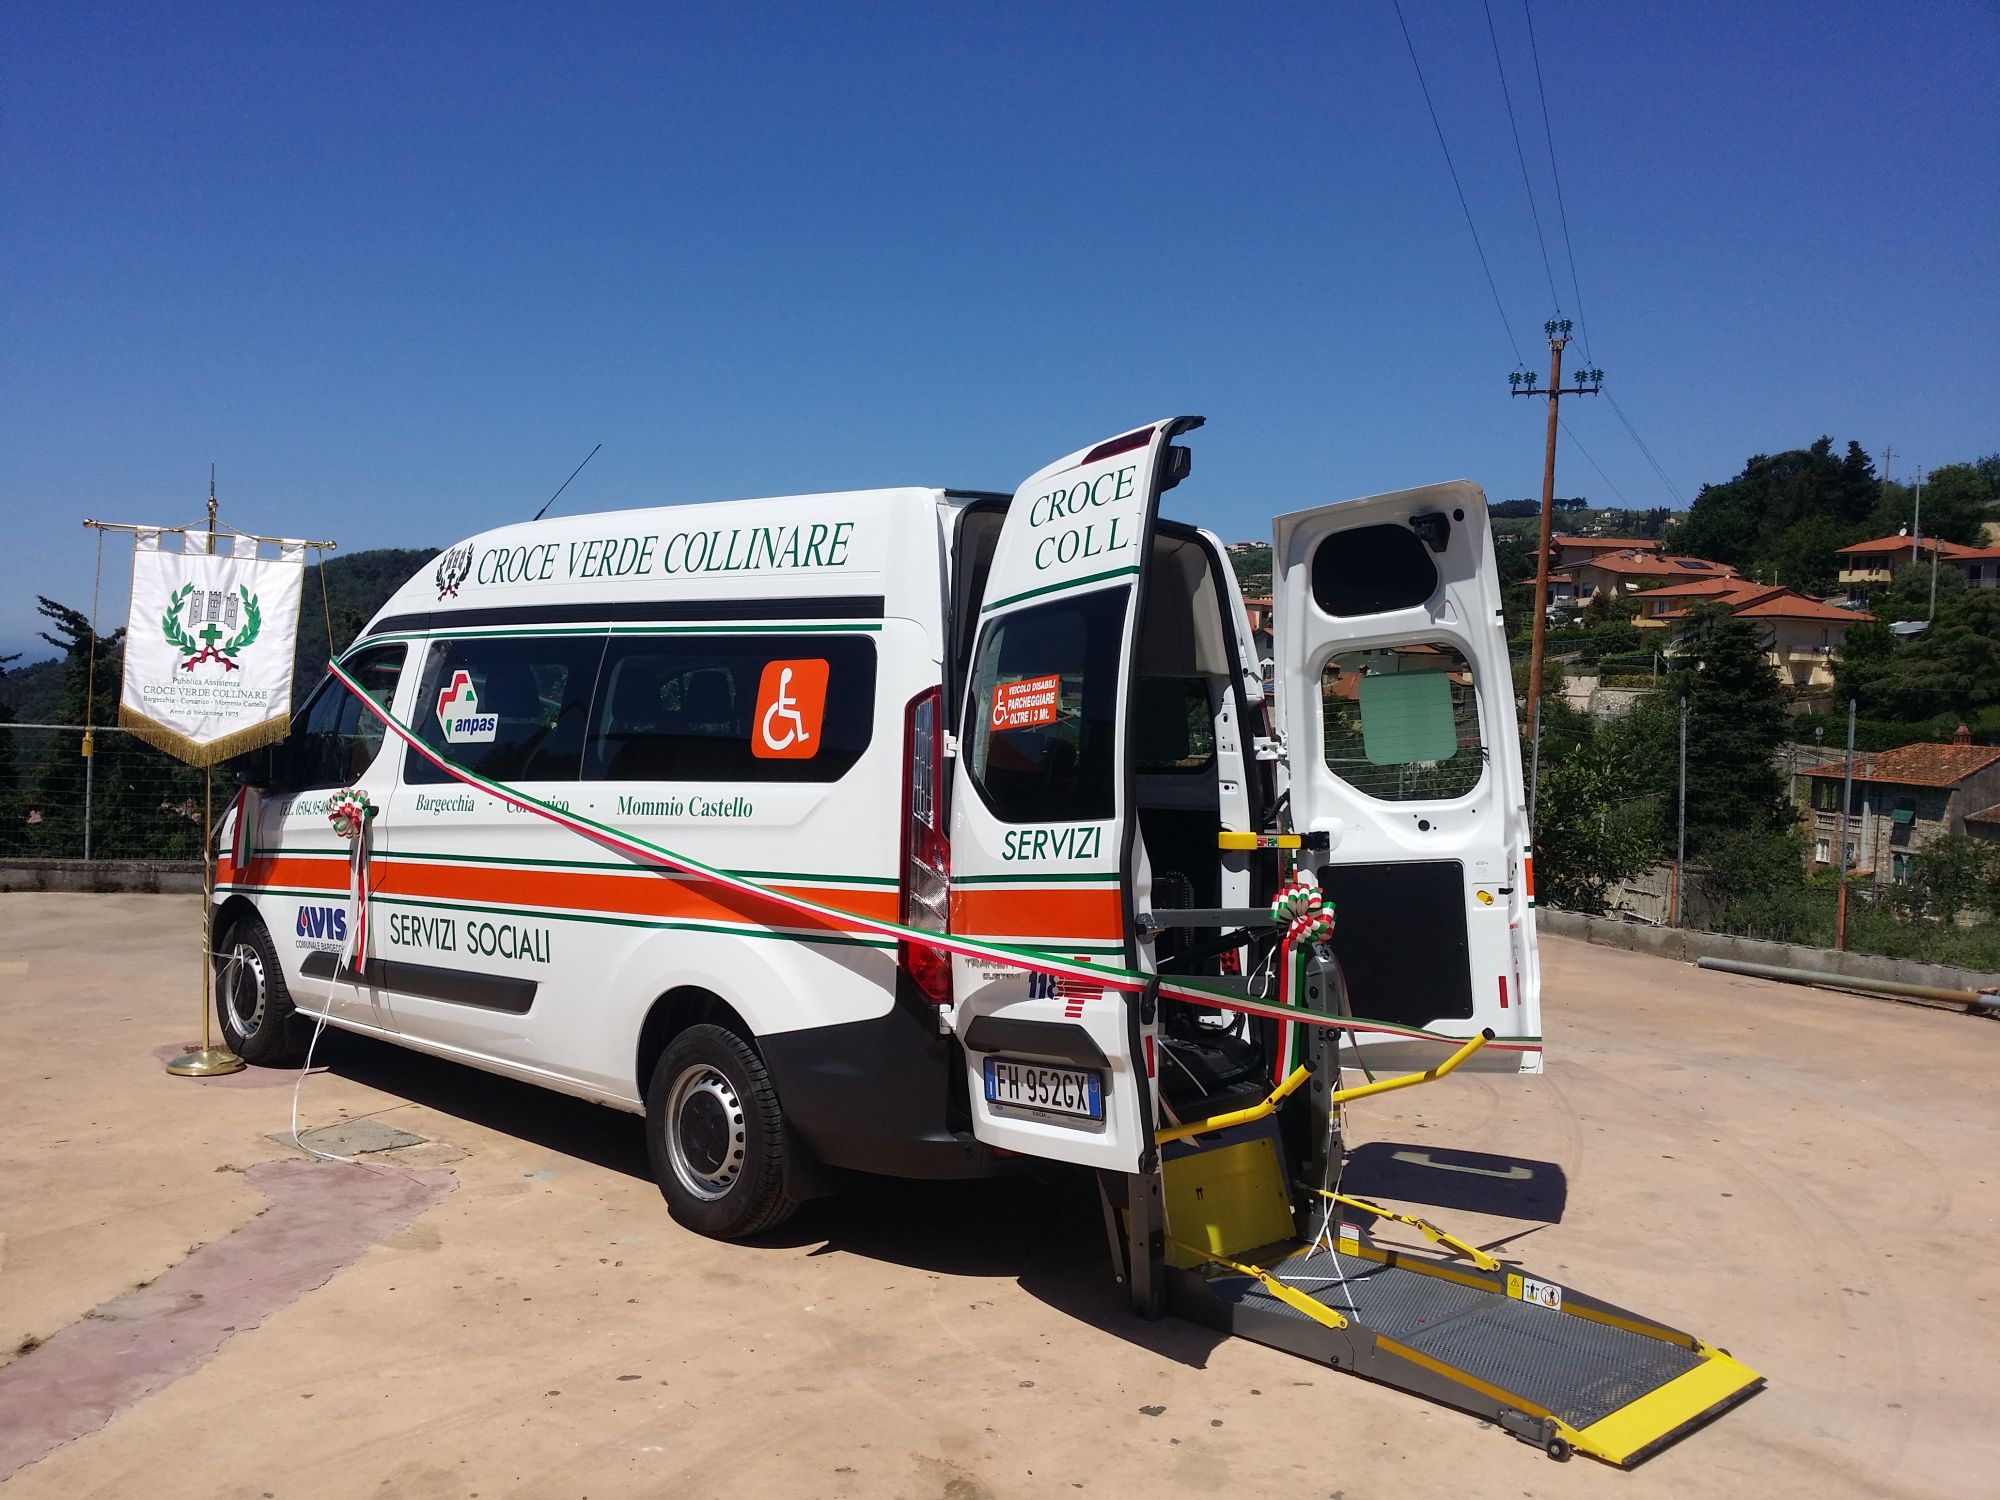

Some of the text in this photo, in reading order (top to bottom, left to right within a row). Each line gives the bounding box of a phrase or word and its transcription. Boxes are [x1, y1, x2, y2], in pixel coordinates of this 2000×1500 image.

[1029, 465, 1137, 528] CROCE
[477, 521, 855, 585] CROCE VERDE COLLINARE
[1035, 516, 1129, 570] COLL
[143, 685, 268, 700] CROCE VERDE COLLINARE
[172, 676, 240, 688] Pubblica Assistenza
[1009, 679, 1056, 695] VEICOLO DISABILI
[1008, 692, 1055, 710] PARCHEGGIARE
[455, 717, 495, 736] anpas
[1010, 710, 1030, 725] OLTRE
[1034, 709, 1039, 721] 3
[416, 793, 475, 816] Bargecchia
[616, 796, 684, 816] Mommio
[688, 796, 753, 818] Castello
[1002, 826, 1102, 861] SERVIZI
[296, 905, 347, 941] AVIS
[295, 940, 321, 951] COMUNALE
[390, 913, 551, 963] SERVIZI SOCIALI
[1028, 970, 1065, 1001] 118
[996, 1064, 1020, 1100] FH
[1026, 1069, 1088, 1111] 952GX
